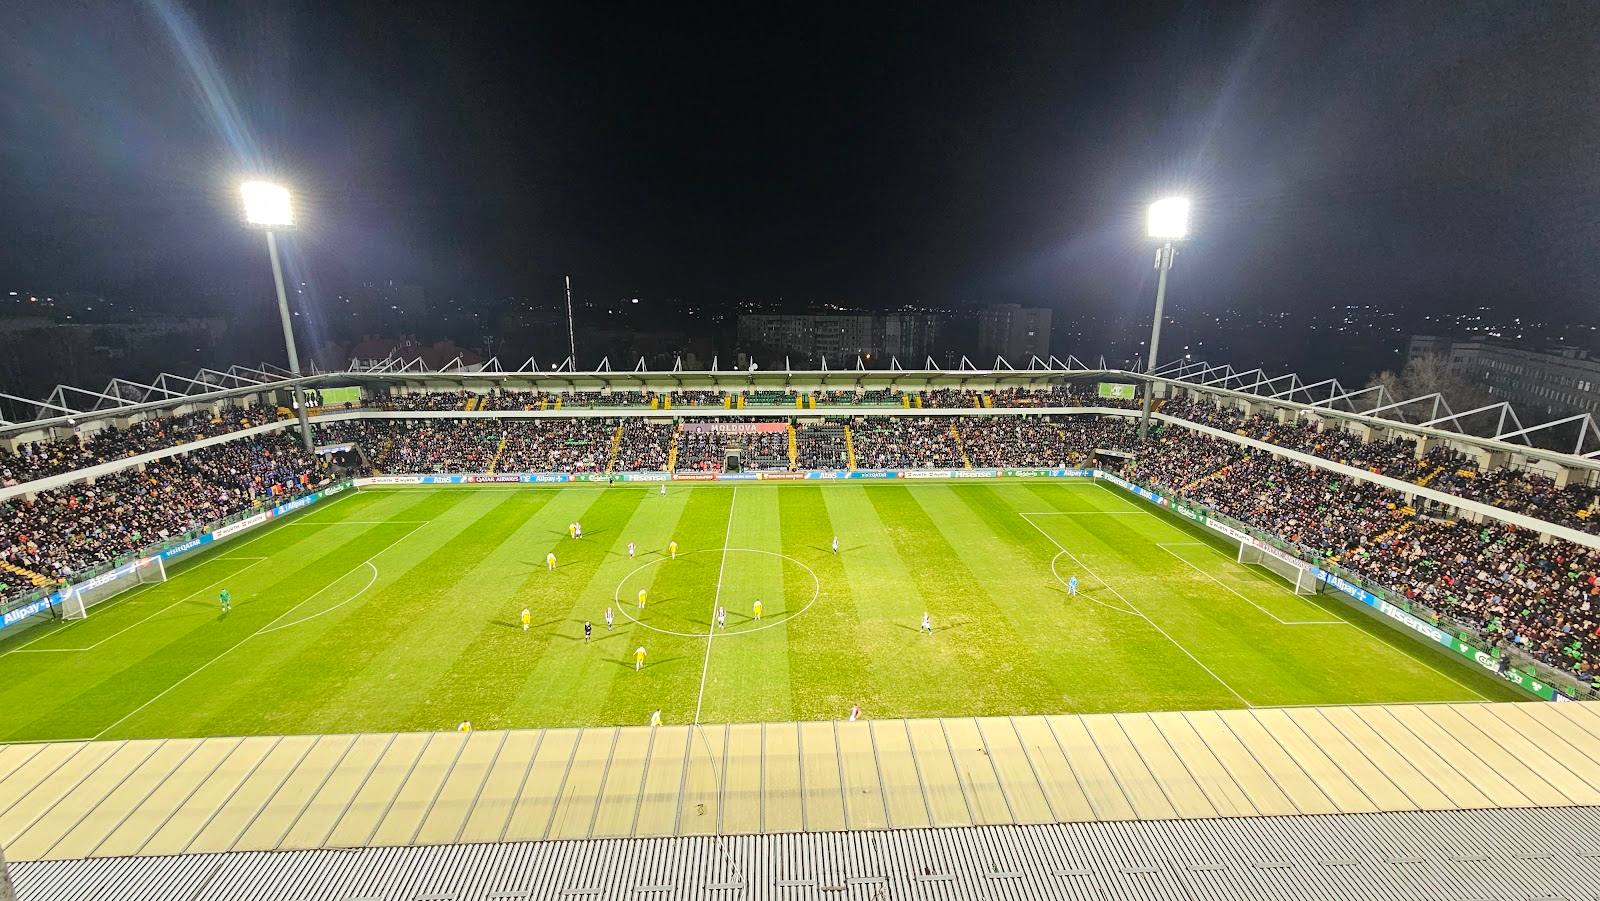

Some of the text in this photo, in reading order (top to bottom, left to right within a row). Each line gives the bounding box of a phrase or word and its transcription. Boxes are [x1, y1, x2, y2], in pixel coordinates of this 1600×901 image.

[711, 424, 757, 432] MOLDOVA
[4, 597, 51, 624] Alipay+
[1380, 601, 1441, 640] Hisense
